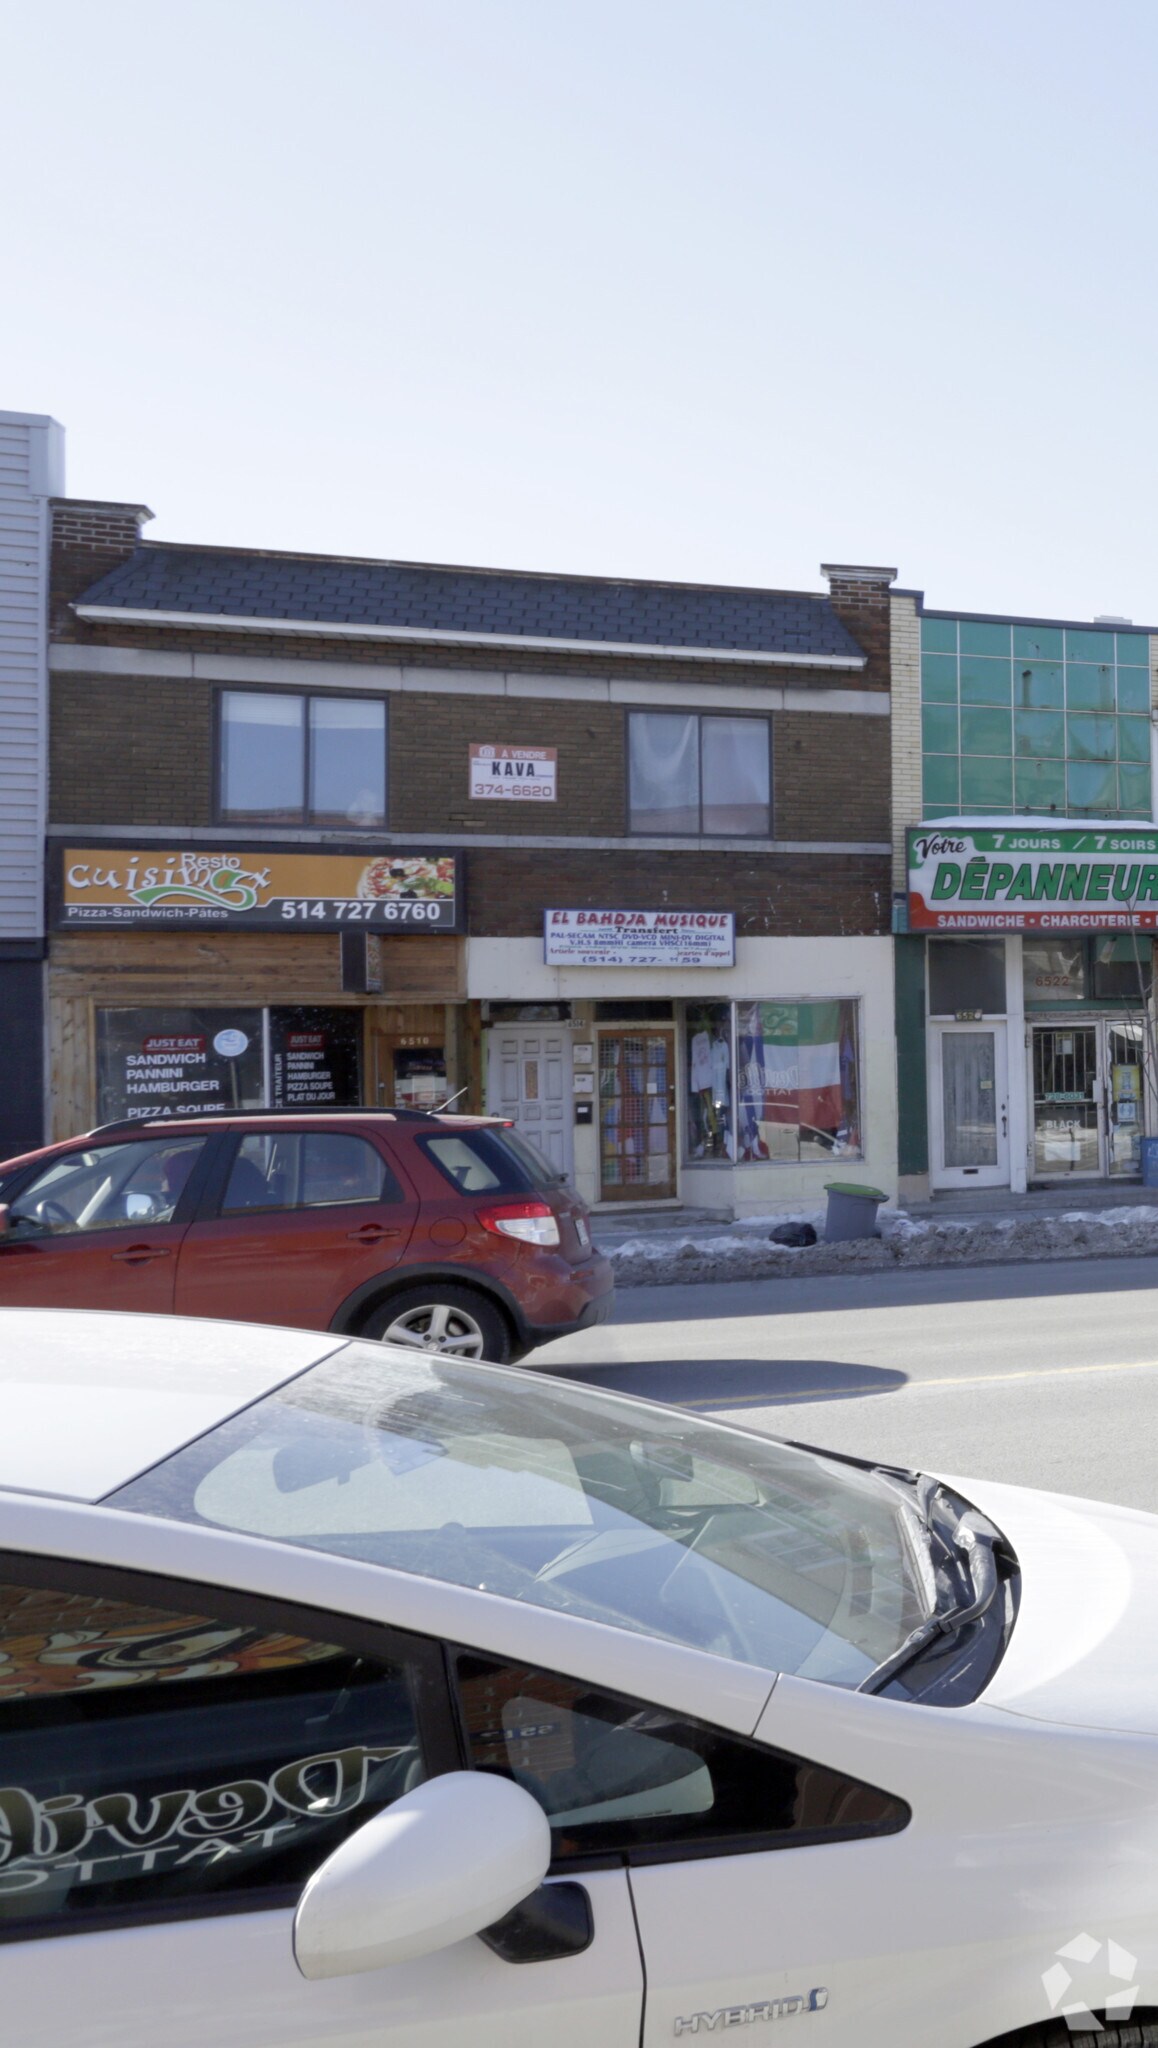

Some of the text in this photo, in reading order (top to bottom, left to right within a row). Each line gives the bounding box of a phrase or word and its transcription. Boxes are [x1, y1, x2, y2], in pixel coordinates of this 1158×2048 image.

[511, 750, 547, 760] VENDRE
[492, 761, 535, 777] KAVA
[474, 783, 552, 797] 374-6620
[916, 834, 967, 859] Votre
[992, 834, 1005, 849] 7
[1008, 838, 1061, 849] JOURS
[1094, 835, 1107, 850] 7
[1110, 839, 1156, 850] SOIRS
[181, 853, 241, 869] Resto
[930, 855, 1158, 901] DÉPANNEUR
[67, 907, 229, 919] Pizza-Sandwich-Pâtes
[281, 901, 440, 920] 514 727 6760
[551, 911, 729, 928] EL BAHDJA MUSIQUE
[937, 914, 1025, 928] SANDWICHE
[1040, 914, 1141, 927] CHARCUTERIE
[615, 925, 678, 934] Transfert
[1035, 976, 1070, 987] 6522
[147, 1038, 201, 1048] JUST EAT
[126, 1053, 206, 1066] SANDWICH
[286, 1051, 325, 1061] SANDWICH
[126, 1068, 183, 1080] PANNINI
[274, 1053, 282, 1097] TRAITEUR
[287, 1071, 331, 1080] HAMBURGER
[127, 1080, 219, 1094] HAMBURGER
[287, 1081, 333, 1091] PIZZA SOUPE
[287, 1091, 336, 1101] PLAT DU JOUR
[127, 1106, 172, 1118] PIZZA
[1046, 1120, 1080, 1129] BLACK
[674, 1995, 804, 2037] HYBRID
